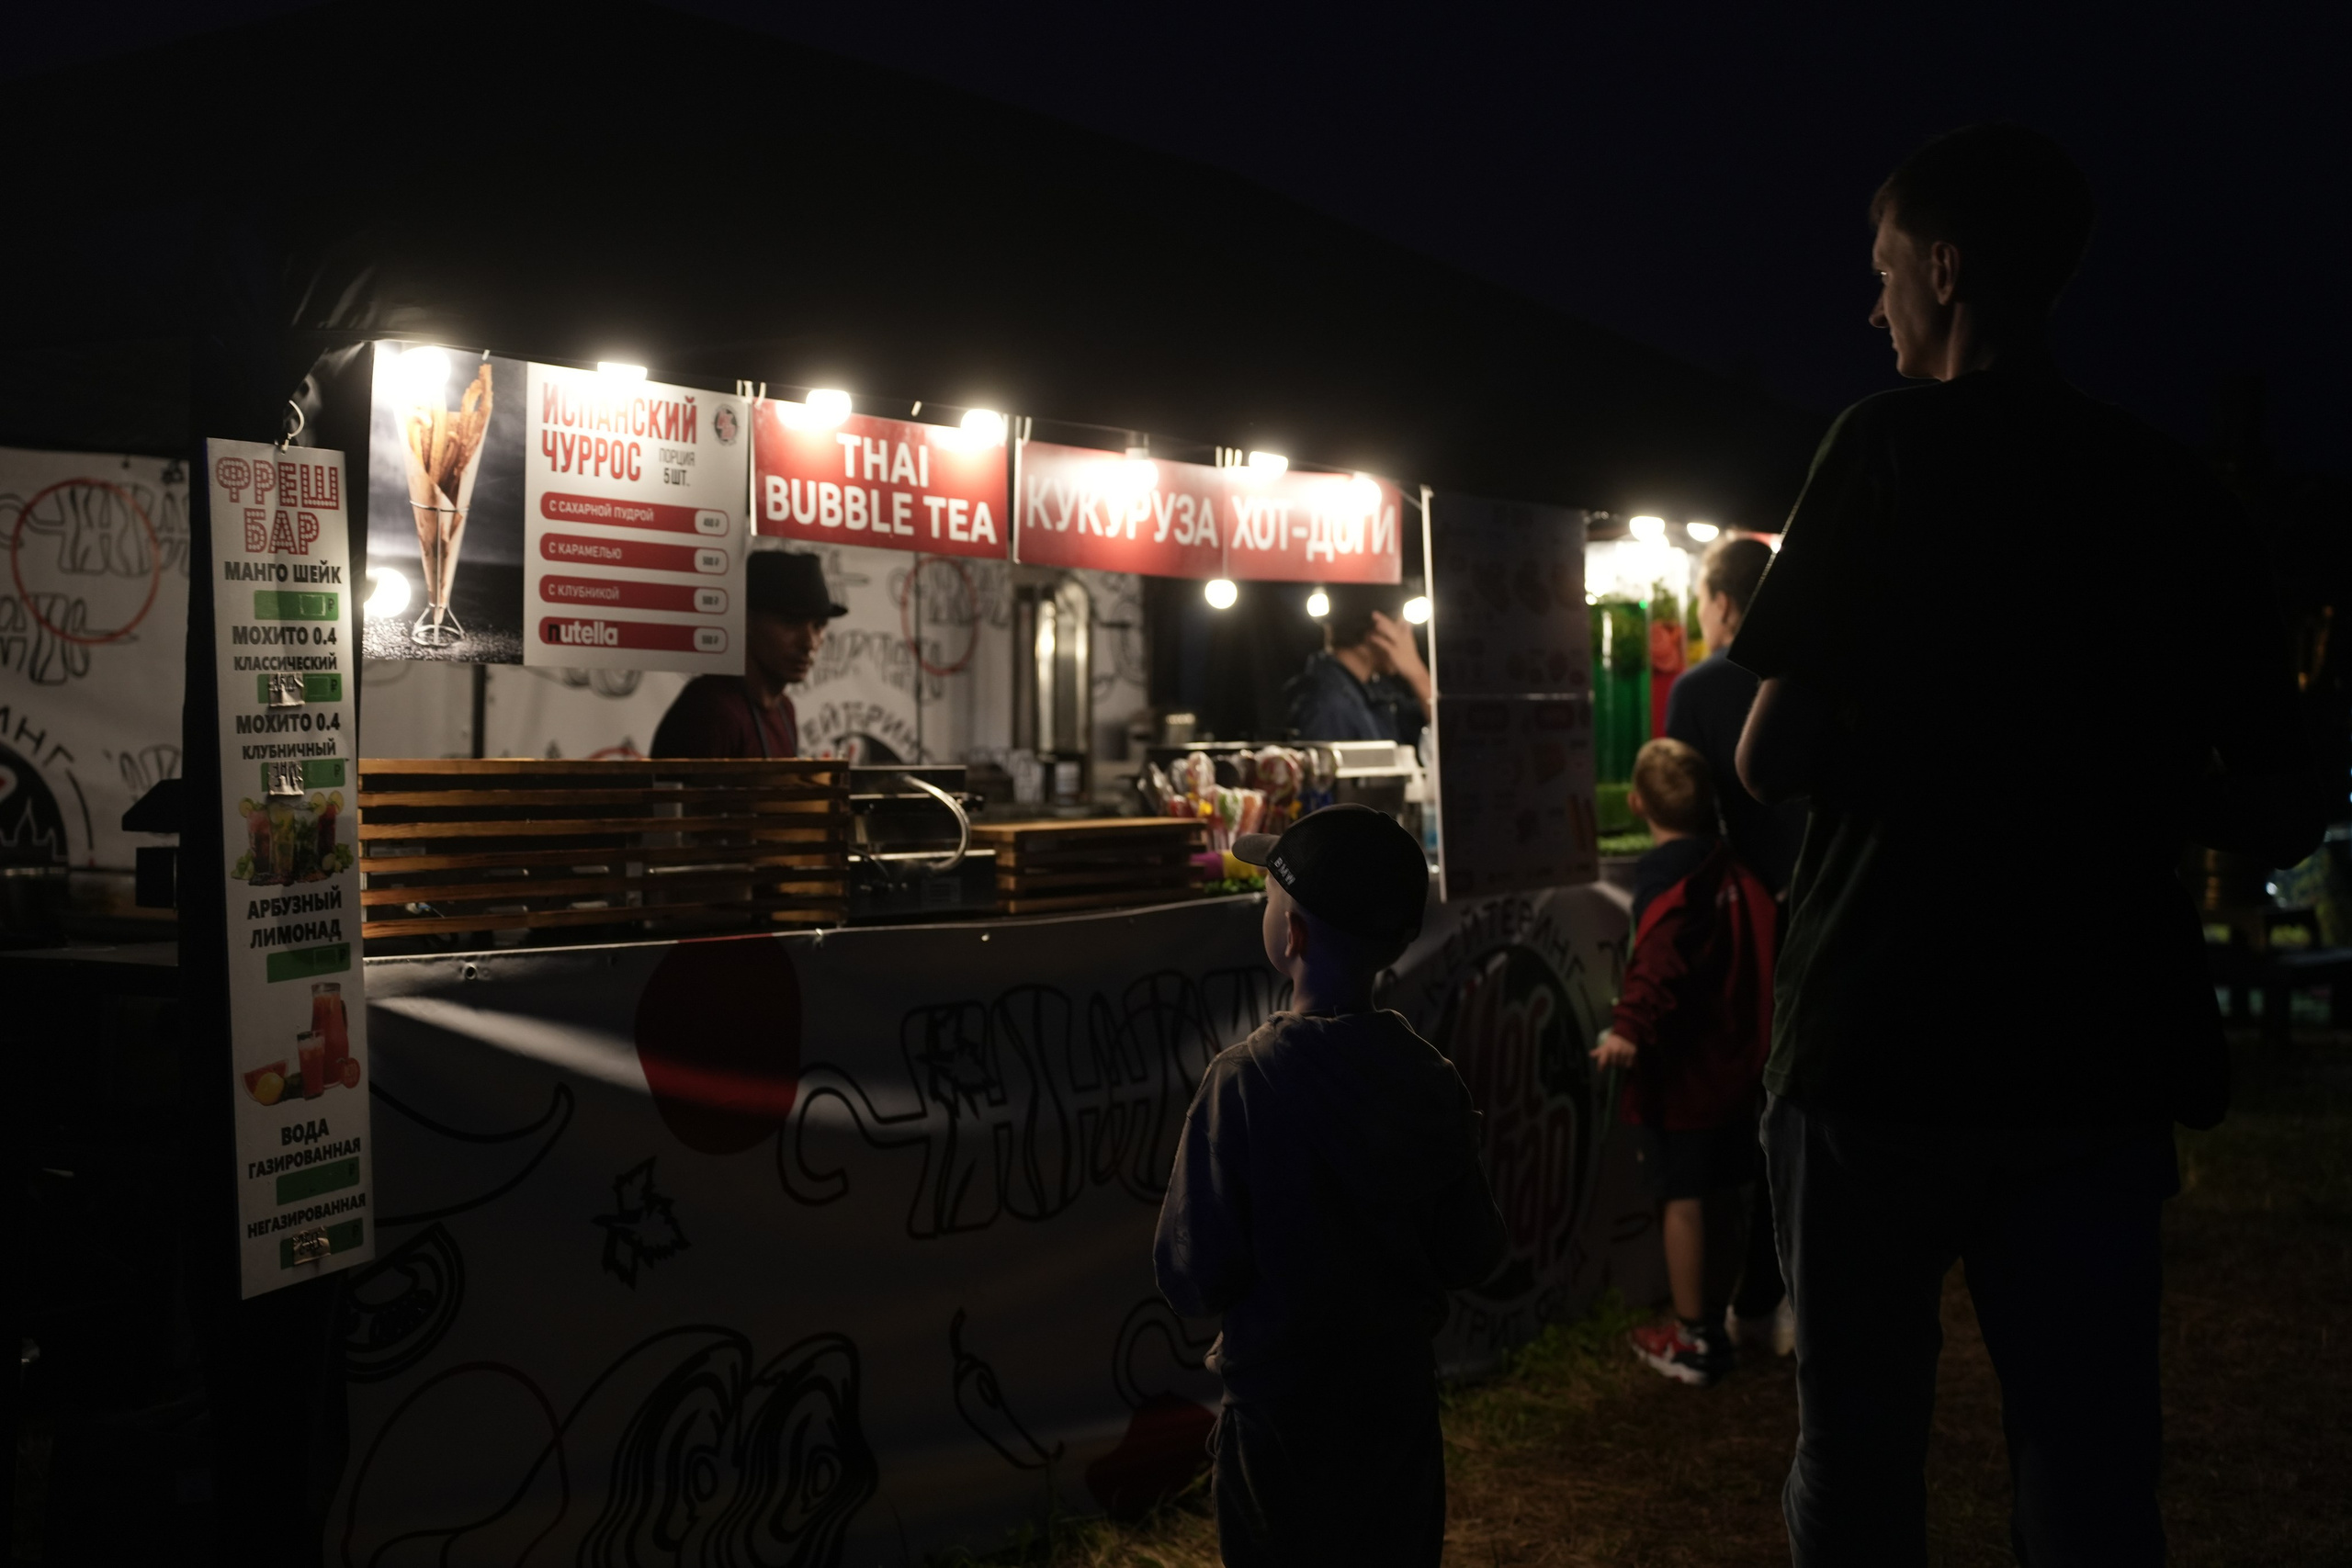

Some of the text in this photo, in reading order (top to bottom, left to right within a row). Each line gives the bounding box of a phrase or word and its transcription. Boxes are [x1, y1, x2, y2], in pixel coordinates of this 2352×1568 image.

[542, 429, 640, 481] ЧУРРОС
[659, 447, 695, 467] ПОРЦИЯ
[835, 432, 929, 488] THAI
[215, 456, 340, 510] ФРЕШ
[548, 501, 654, 522] С САХАРНОЙ ПУДРОЙ
[765, 475, 998, 545] BUBBLE TEA
[243, 507, 320, 555] БАР
[548, 542, 622, 560] С КАРАМЕЛЬЮ
[224, 559, 342, 584] МАНГО ШЕЙК
[548, 583, 620, 601] С КЛУБНИКОЙ
[232, 626, 337, 645] МОХИТО 0.4
[548, 621, 618, 647] nutella
[233, 652, 337, 671] КЛАССИЧЕСКИЙ
[235, 712, 341, 734] МОХИТО 0.4
[242, 738, 336, 760] КЛУБНИЧНЫЙ
[1273, 856, 1296, 886] BMW
[247, 885, 342, 920] АРБУЗНЫЙ
[250, 919, 342, 949] ЛИМОНАД
[280, 1118, 330, 1146] ВОДА
[248, 1137, 361, 1179] ГАЗИРОВАННАЯ
[247, 1192, 367, 1239] НЕГАЗИРОВАННАЯ
